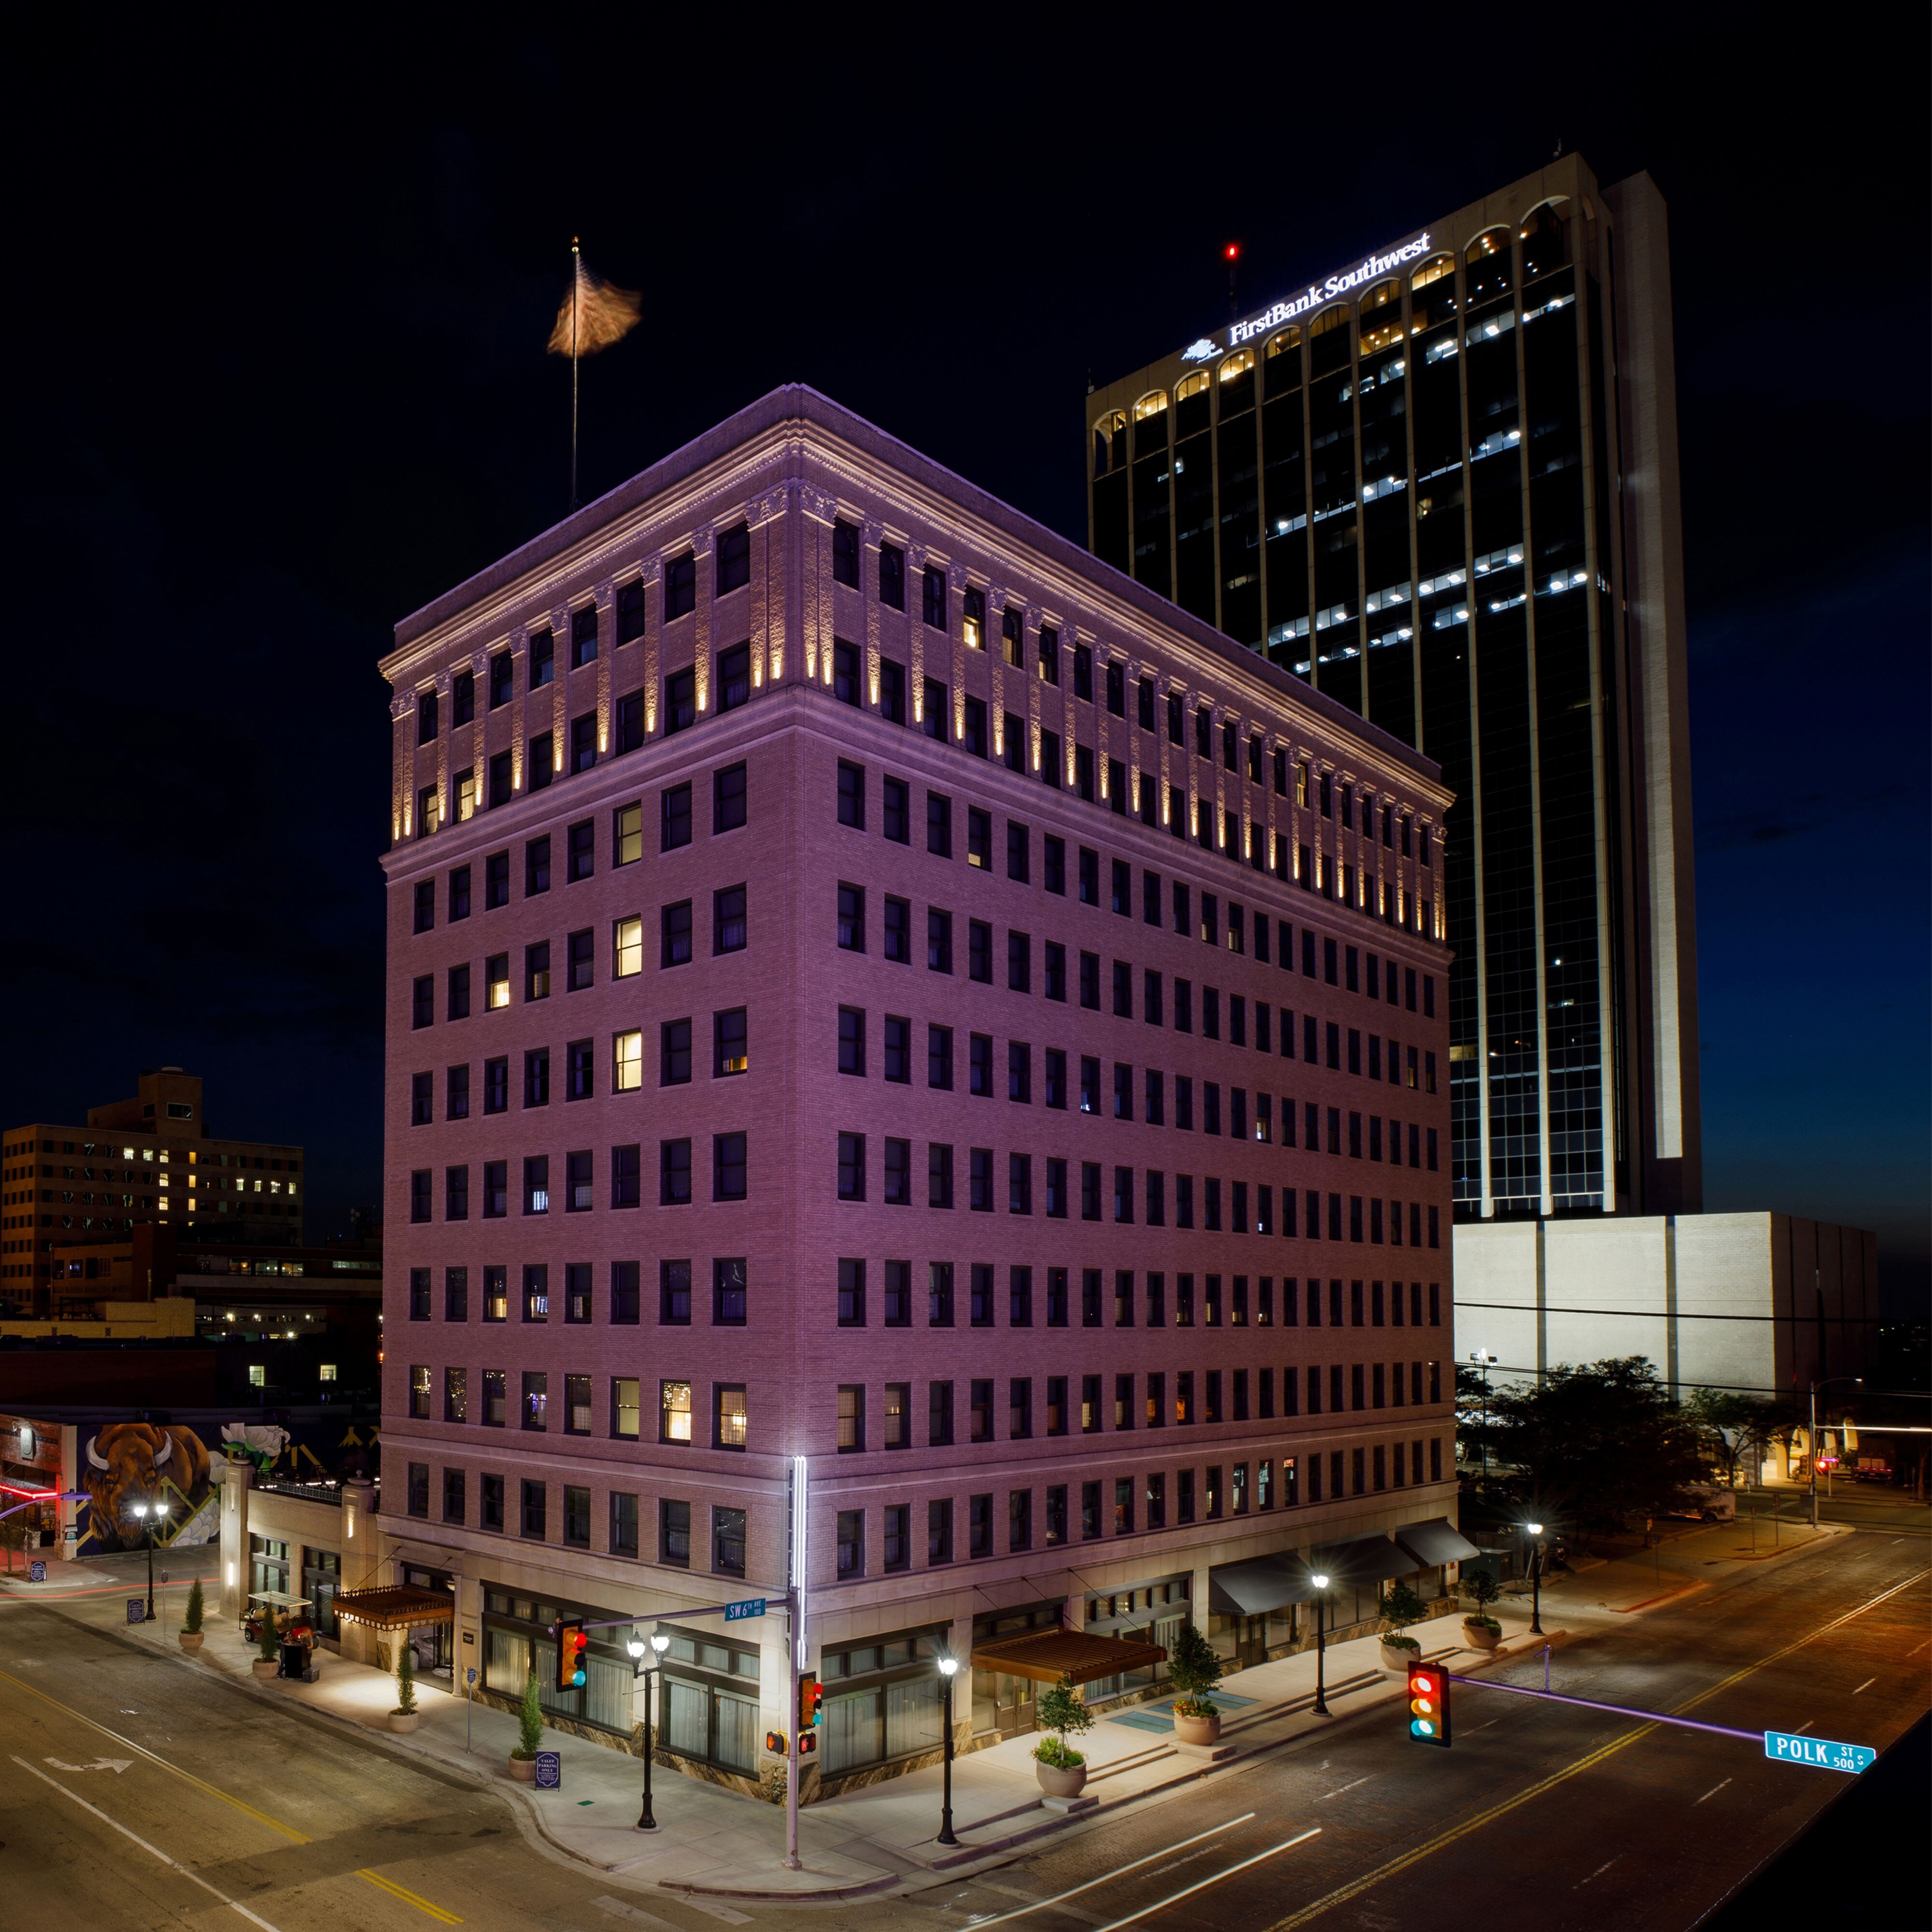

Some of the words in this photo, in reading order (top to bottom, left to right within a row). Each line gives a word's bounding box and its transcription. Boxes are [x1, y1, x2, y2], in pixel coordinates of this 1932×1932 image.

[1230, 286, 1324, 346] FirstBank
[1325, 233, 1430, 299] Southwest
[730, 1604, 741, 1618] SW
[742, 1603, 752, 1616] 6TH
[1777, 1737, 1828, 1763] POLK
[1841, 1747, 1853, 1757] ST
[1857, 1755, 1863, 1765] S
[1833, 1757, 1854, 1770] 500
